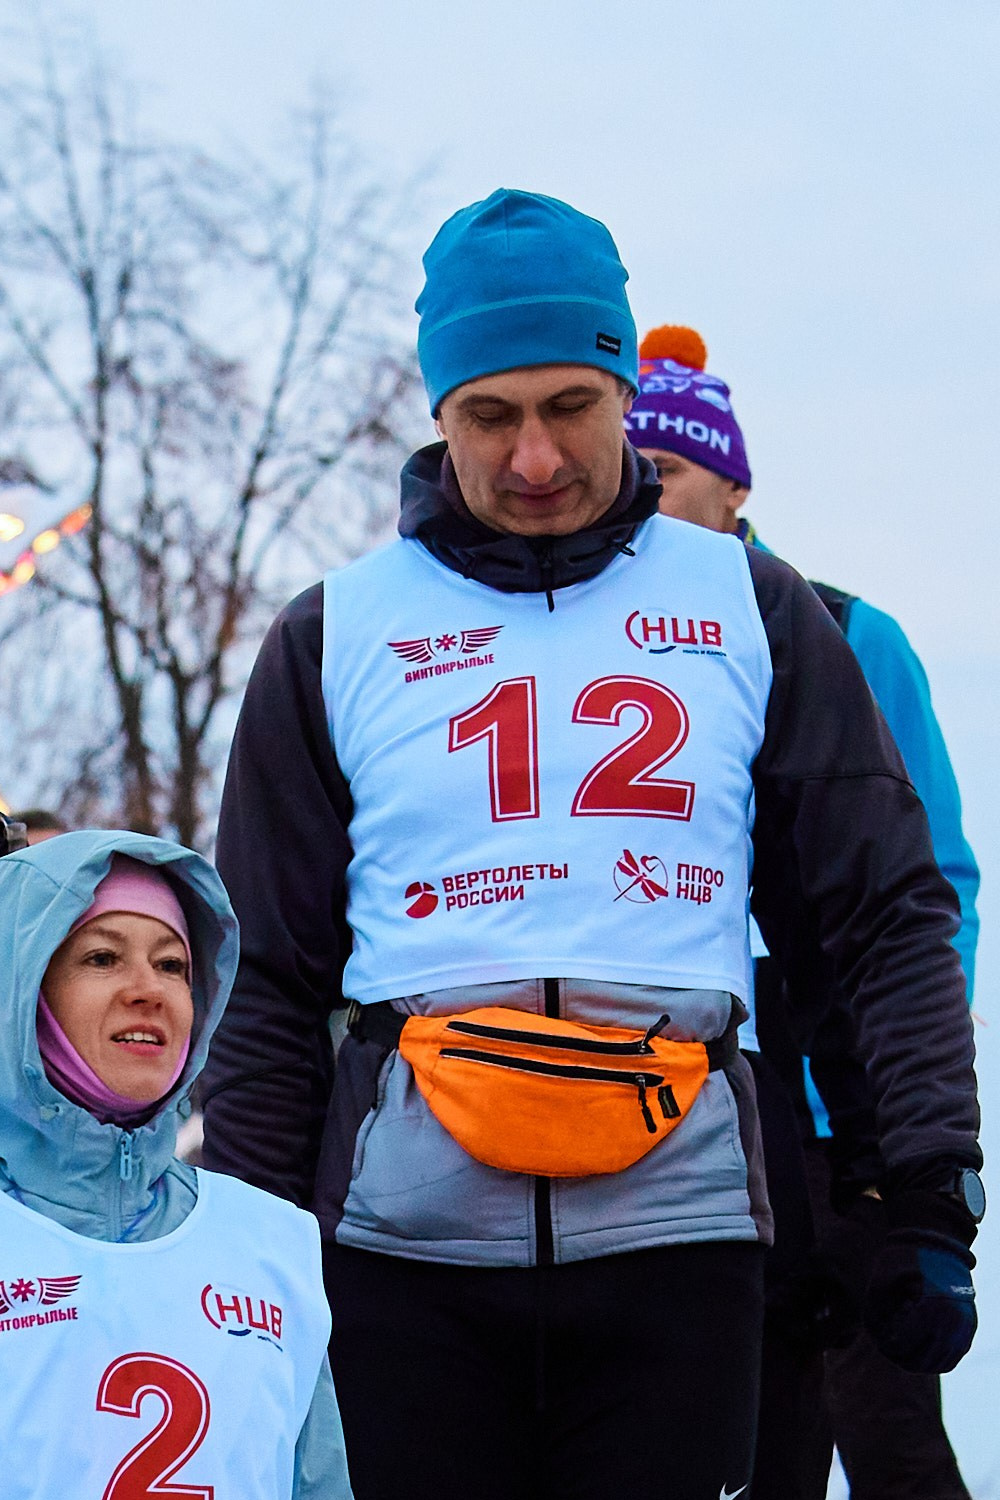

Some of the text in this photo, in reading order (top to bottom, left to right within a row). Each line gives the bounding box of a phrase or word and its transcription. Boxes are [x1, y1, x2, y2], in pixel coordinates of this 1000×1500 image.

[640, 616, 723, 647] НЦВ
[405, 652, 495, 684] ВИНТОКРЫЛЫЕ
[448, 675, 696, 822] 12
[442, 863, 569, 891] ВЕРТОЛЕТЫ
[676, 863, 724, 888] ППОО
[445, 883, 525, 911] РОССИИ
[676, 882, 712, 906] НЦВ
[214, 1293, 283, 1340] НЦВ
